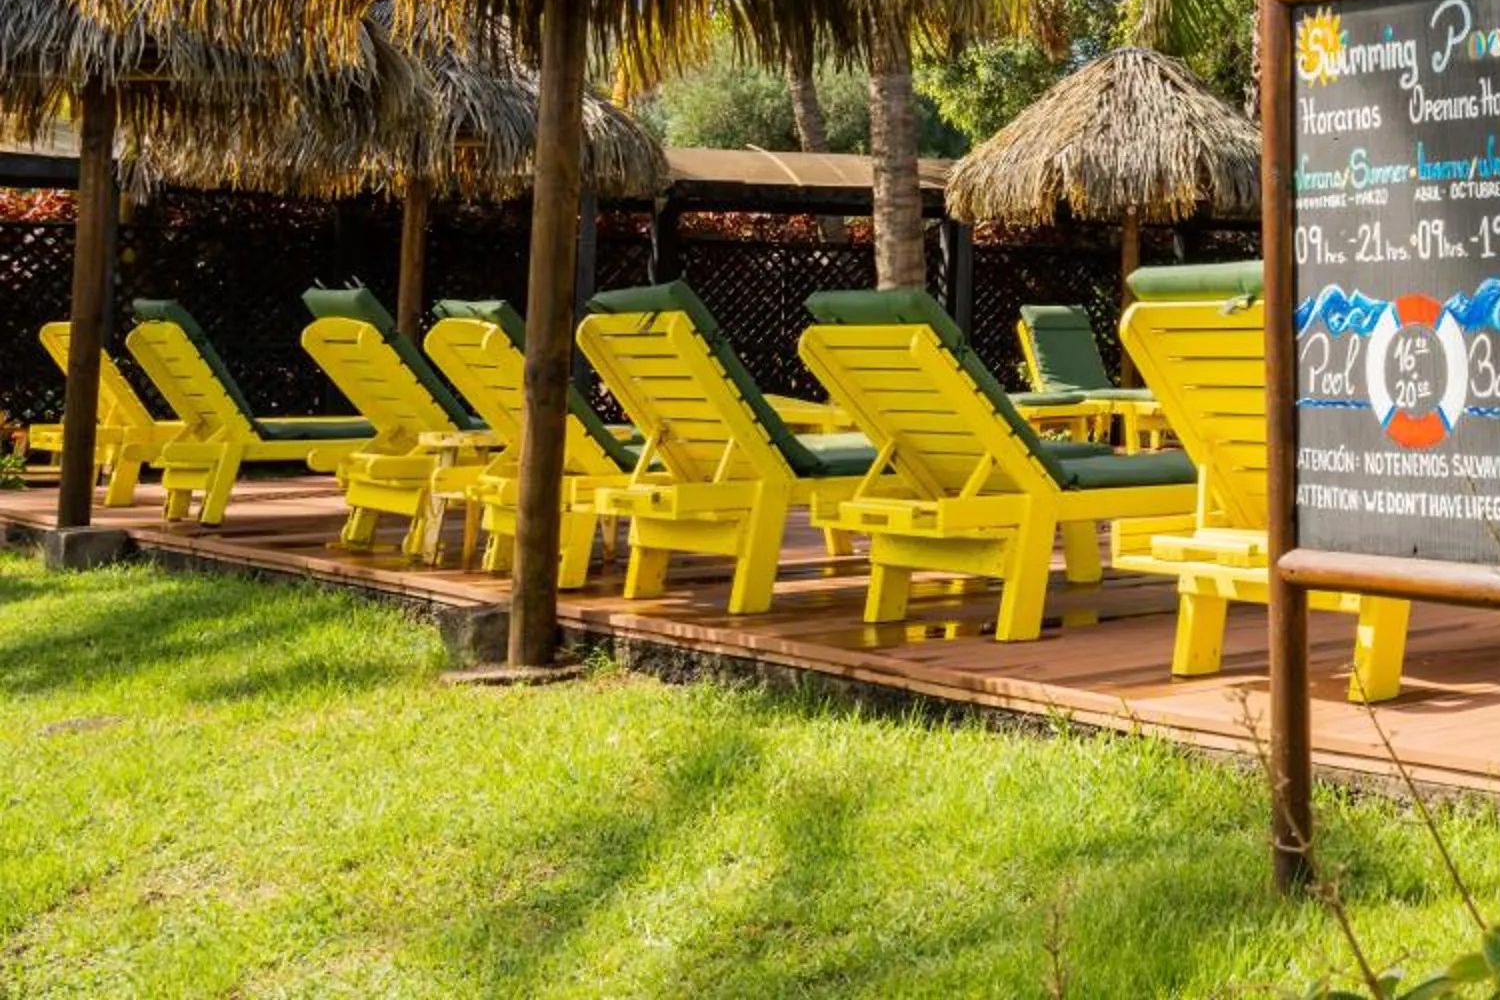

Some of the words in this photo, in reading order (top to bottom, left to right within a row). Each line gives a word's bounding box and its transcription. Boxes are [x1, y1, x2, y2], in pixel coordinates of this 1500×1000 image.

[1298, 23, 1418, 89] Swimming
[1300, 96, 1382, 135] Horarios
[1299, 332, 1360, 395] Pool
[1364, 450, 1385, 475] NO
[1384, 451, 1449, 478] TENEMOS
[1362, 488, 1385, 514] WE
[1429, 493, 1463, 519] HAVE
